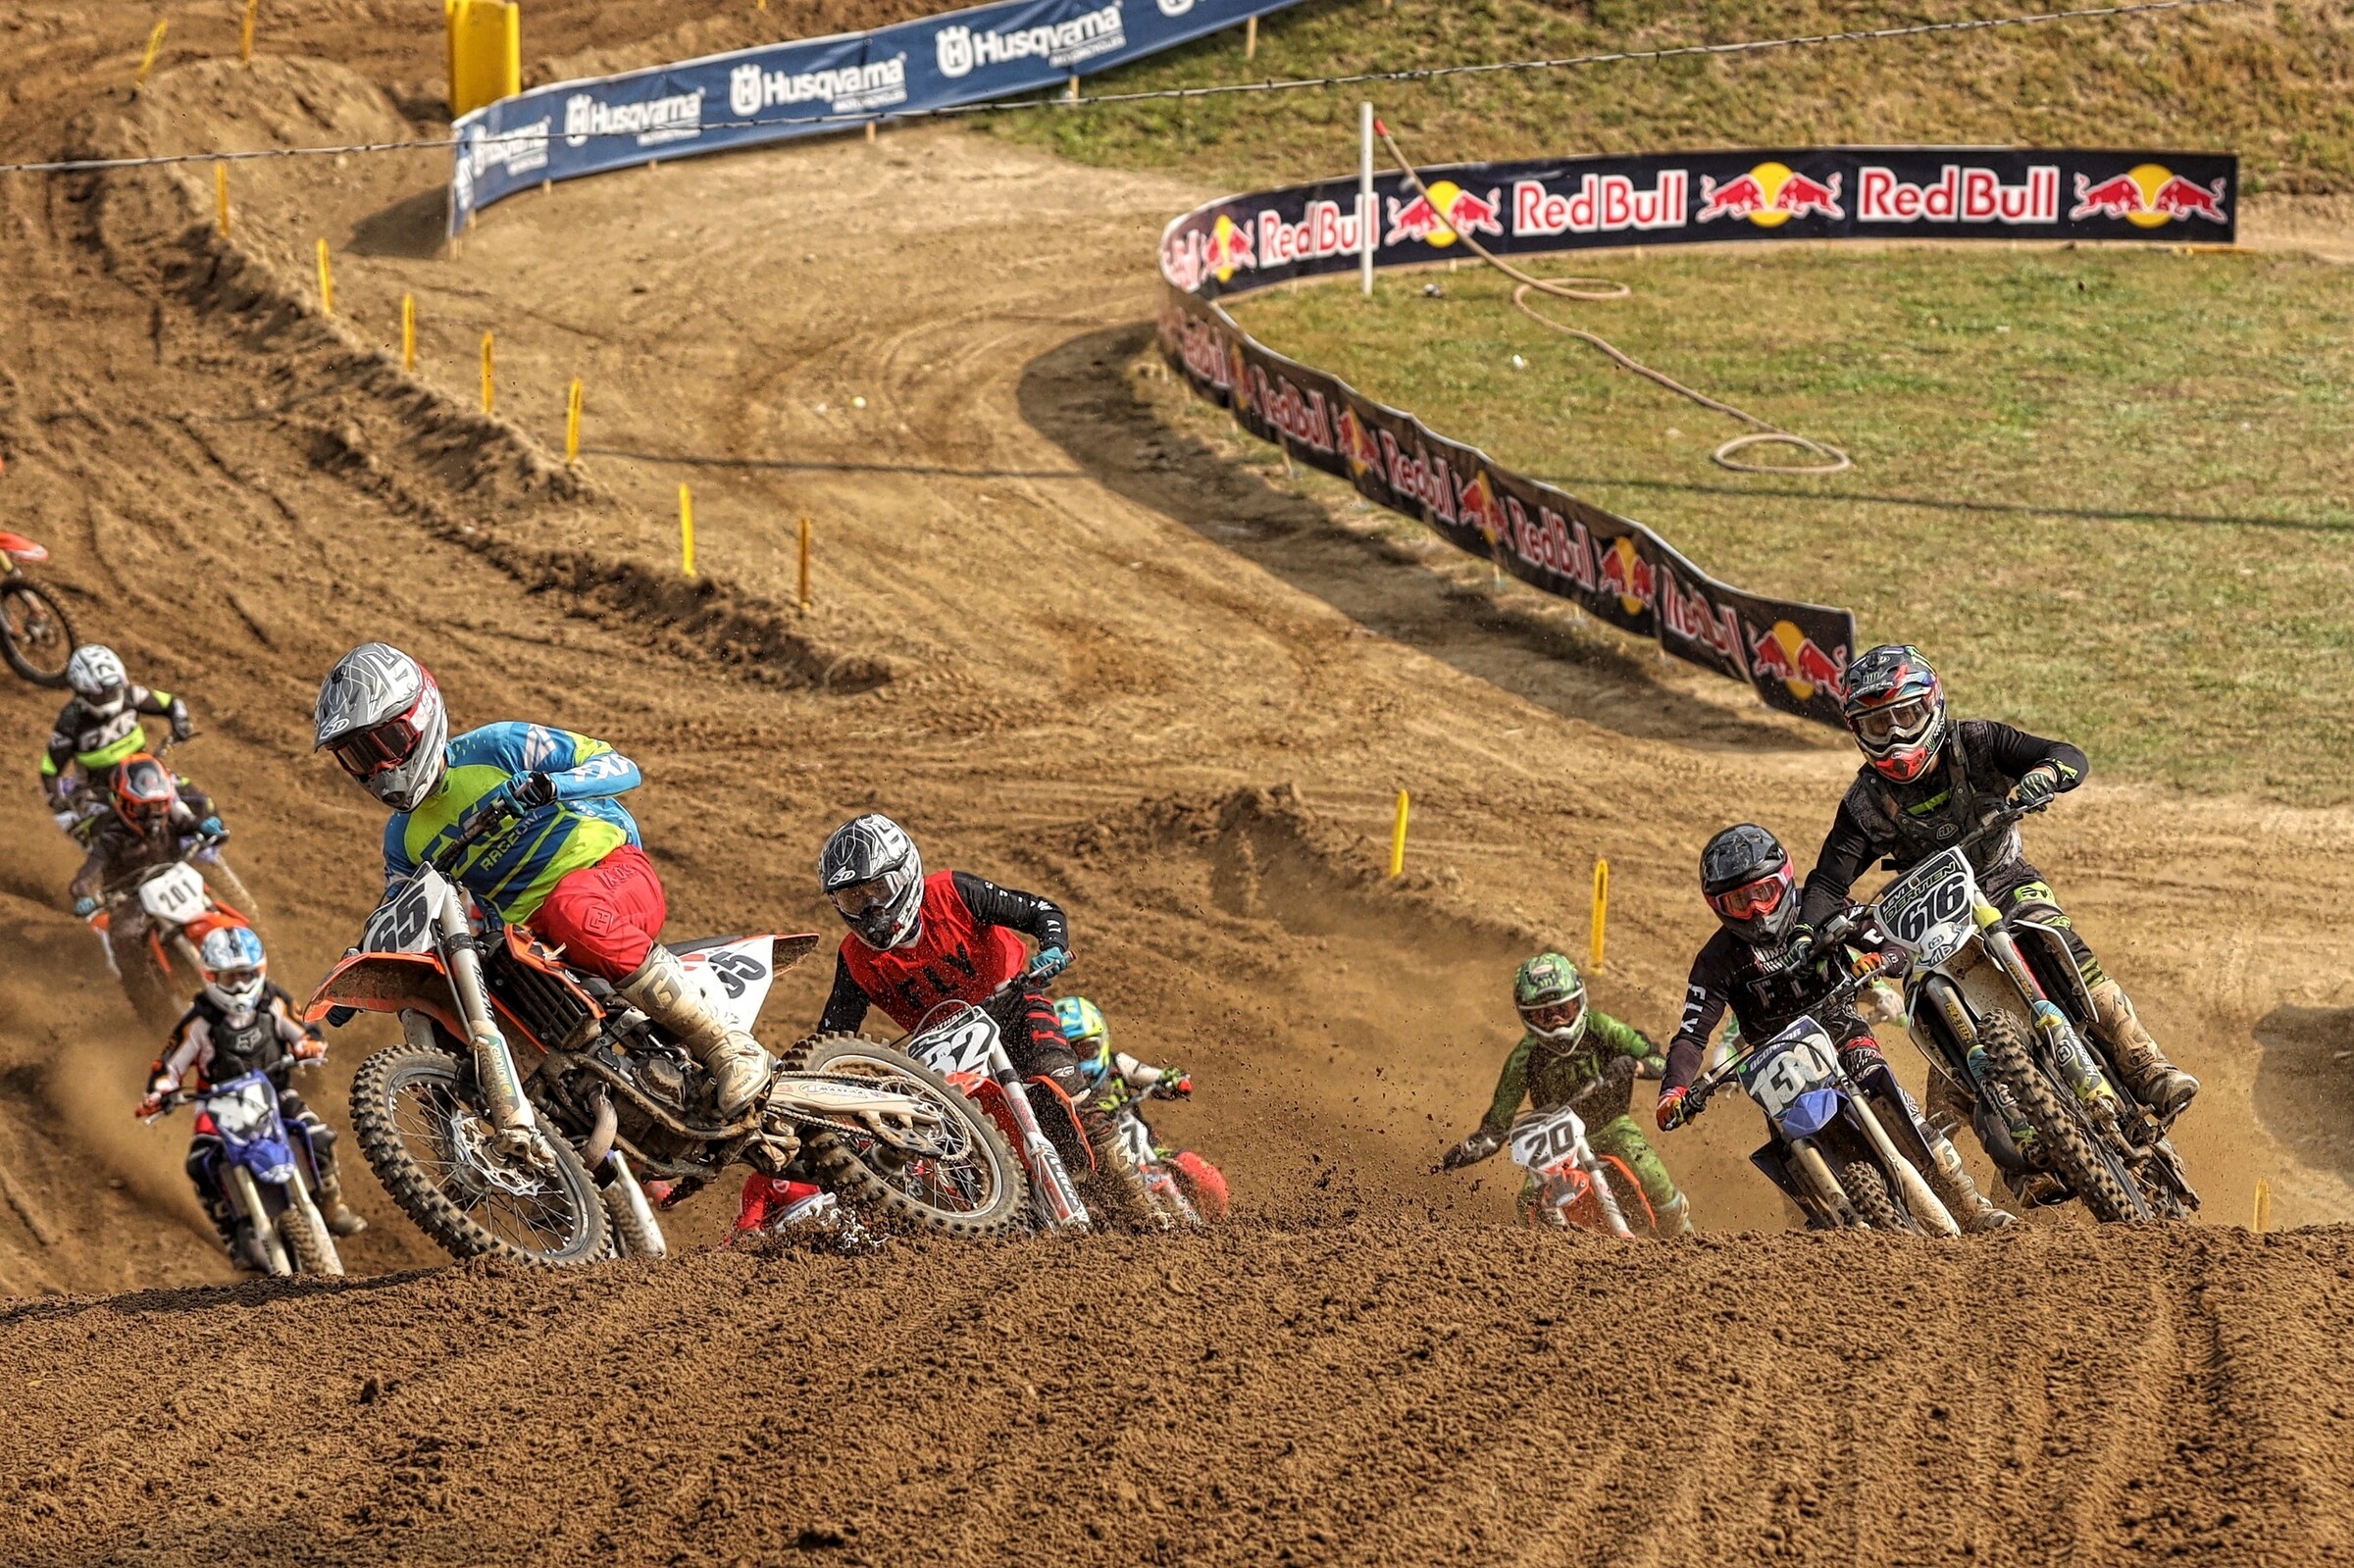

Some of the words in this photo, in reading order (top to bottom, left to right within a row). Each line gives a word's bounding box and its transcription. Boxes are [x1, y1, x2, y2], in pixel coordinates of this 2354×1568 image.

[972, 5, 1123, 66] Husqvarna
[762, 58, 907, 106] Husqvarna
[1513, 174, 1600, 237] Red
[1601, 170, 1689, 232] Bull
[1858, 165, 1961, 223] Red
[1962, 167, 2060, 224] Bull
[1258, 201, 1316, 269] Red
[1316, 192, 1380, 259] Bul
[159, 879, 198, 912] 201
[1884, 887, 1906, 913] LEVI
[1885, 861, 1956, 924] DERTIEN
[1898, 872, 1968, 942] 616
[896, 943, 976, 1008] FLY
[919, 1022, 992, 1076] 32
[1525, 1120, 1576, 1169] 20
